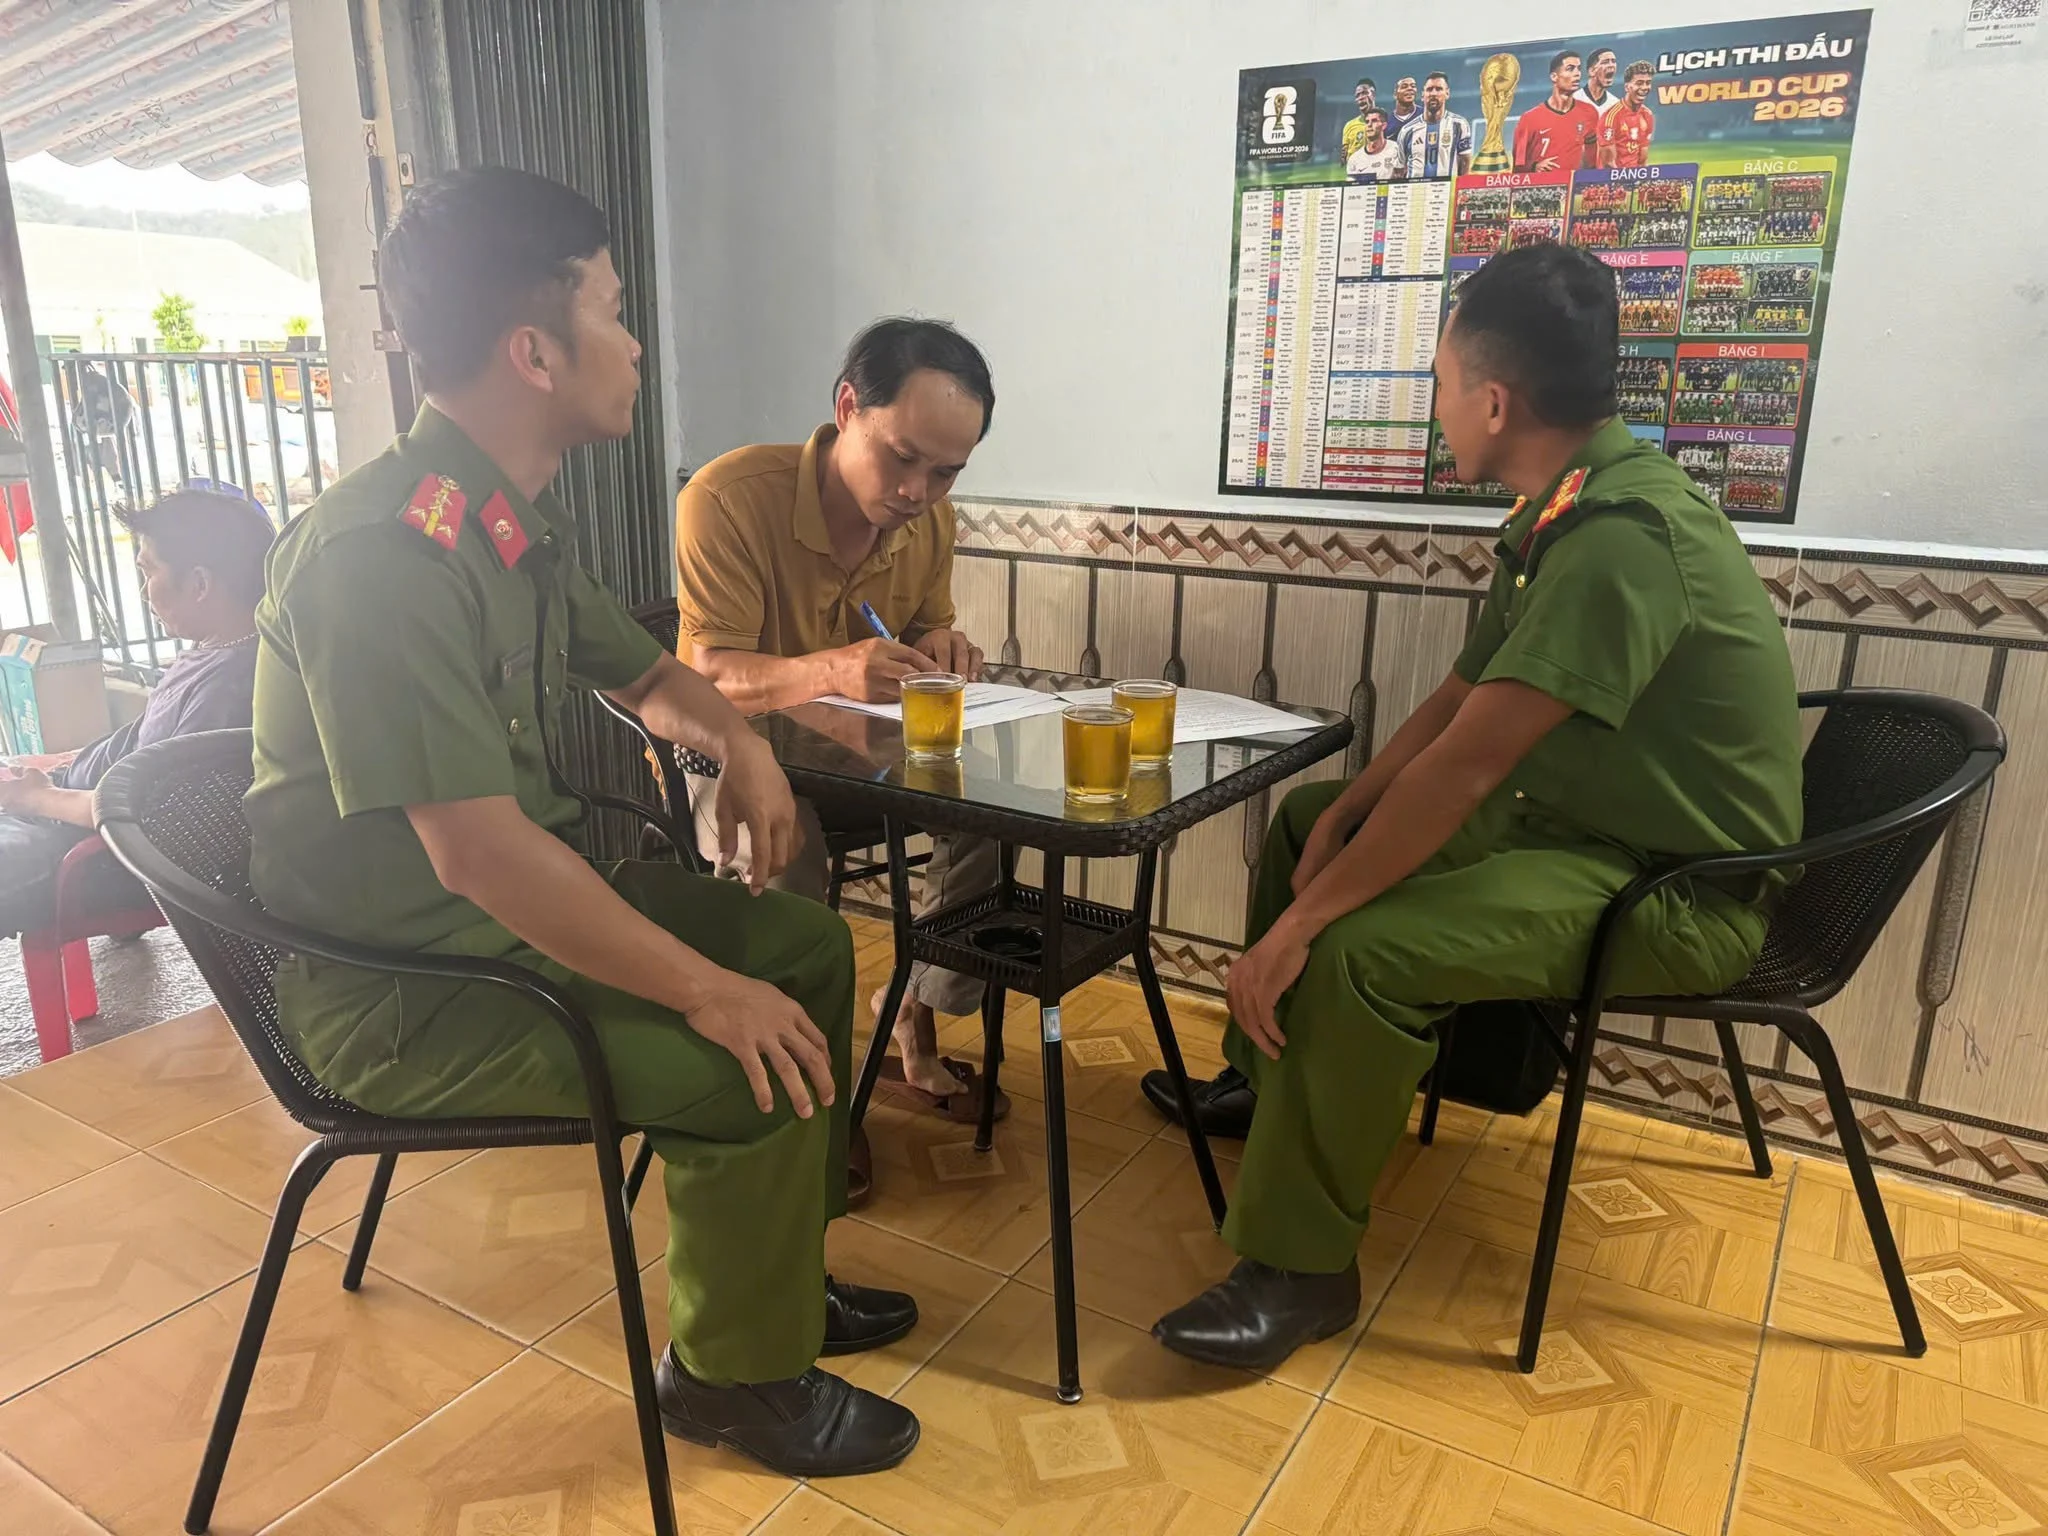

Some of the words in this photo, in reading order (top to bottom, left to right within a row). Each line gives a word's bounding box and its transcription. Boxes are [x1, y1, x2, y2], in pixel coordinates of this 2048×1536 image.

[1659, 49, 1726, 74] LỊCH
[1732, 45, 1780, 65] THI
[1785, 32, 1853, 61] ĐẤU
[1658, 79, 1773, 105] WORLD
[1777, 72, 1849, 96] CUP
[1753, 97, 1845, 121] 2026
[1271, 132, 1286, 140] FIFA
[1540, 138, 1550, 157] 7
[1610, 167, 1649, 180] BẢNG
[1651, 167, 1660, 178] B
[1743, 161, 1783, 174] BẢNG
[1787, 160, 1799, 172] C
[1486, 174, 1520, 187] BẢNG
[1521, 176, 1531, 185] A
[1640, 253, 1649, 264] E
[1731, 250, 1770, 263] BẢNG
[1774, 251, 1784, 262] F
[1629, 345, 1639, 356] H
[1718, 344, 1757, 357] BẢNG
[1761, 346, 1766, 356] I
[1707, 428, 1744, 441] BẢNG
[1748, 431, 1756, 441] L
